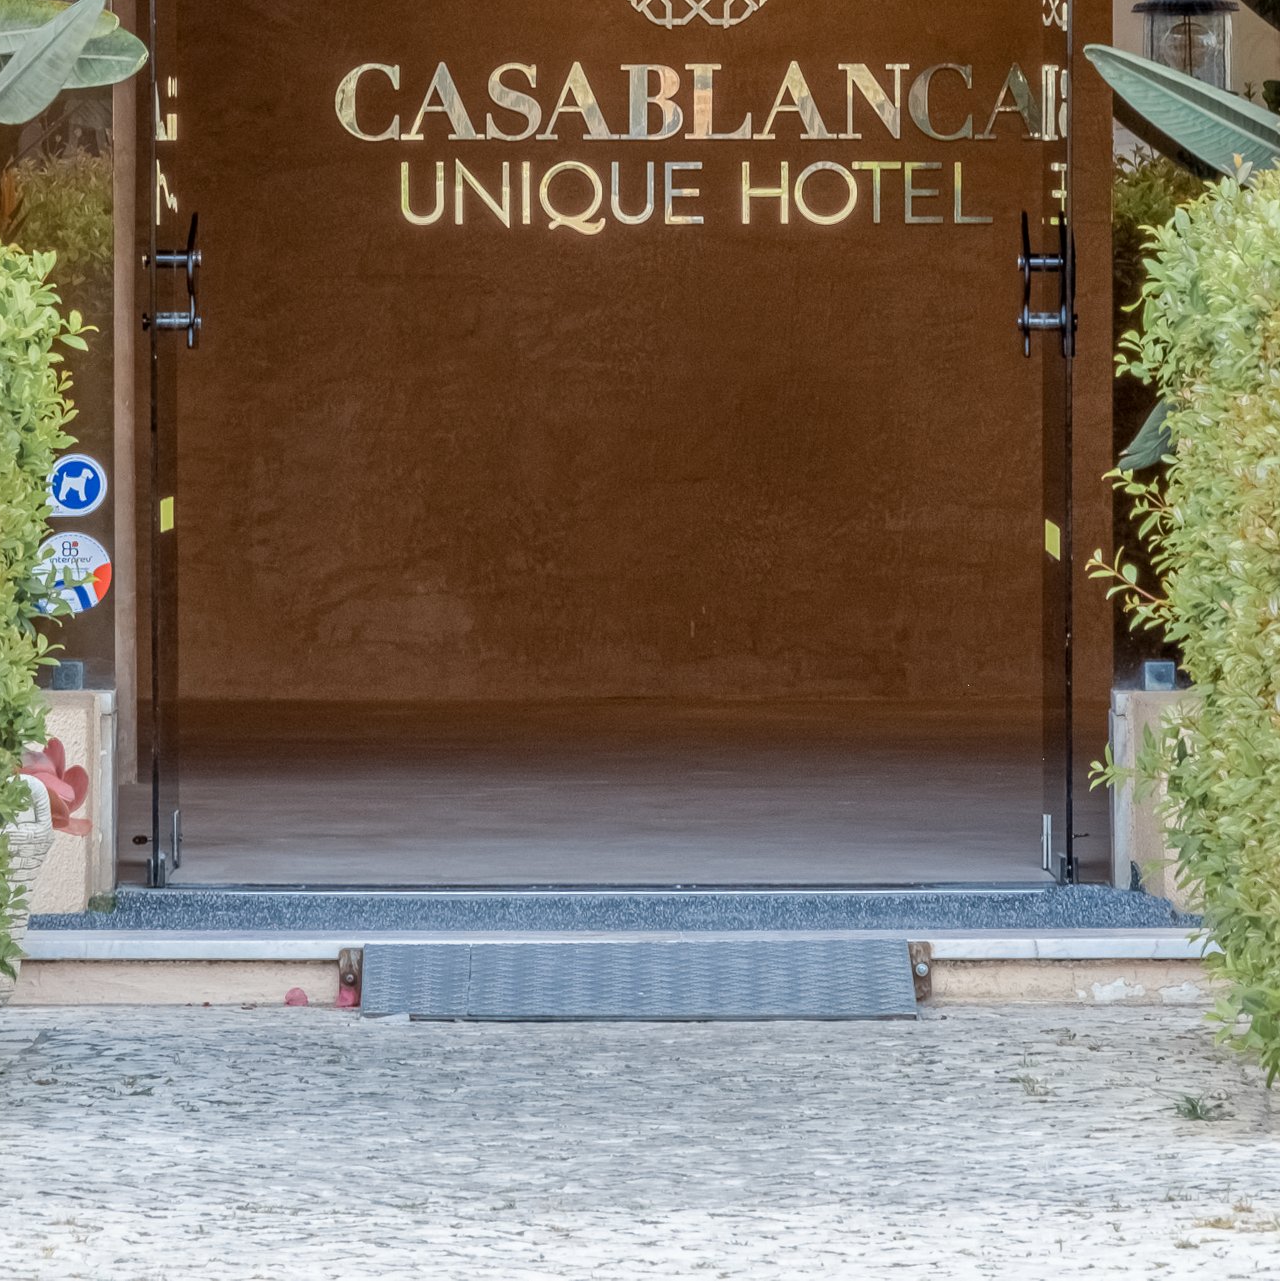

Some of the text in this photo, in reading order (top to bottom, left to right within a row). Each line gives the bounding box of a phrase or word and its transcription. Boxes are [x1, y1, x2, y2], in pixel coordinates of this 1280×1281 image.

[334, 61, 1044, 141] CASABLANCA
[400, 158, 994, 235] UNIQUE HOTEL
